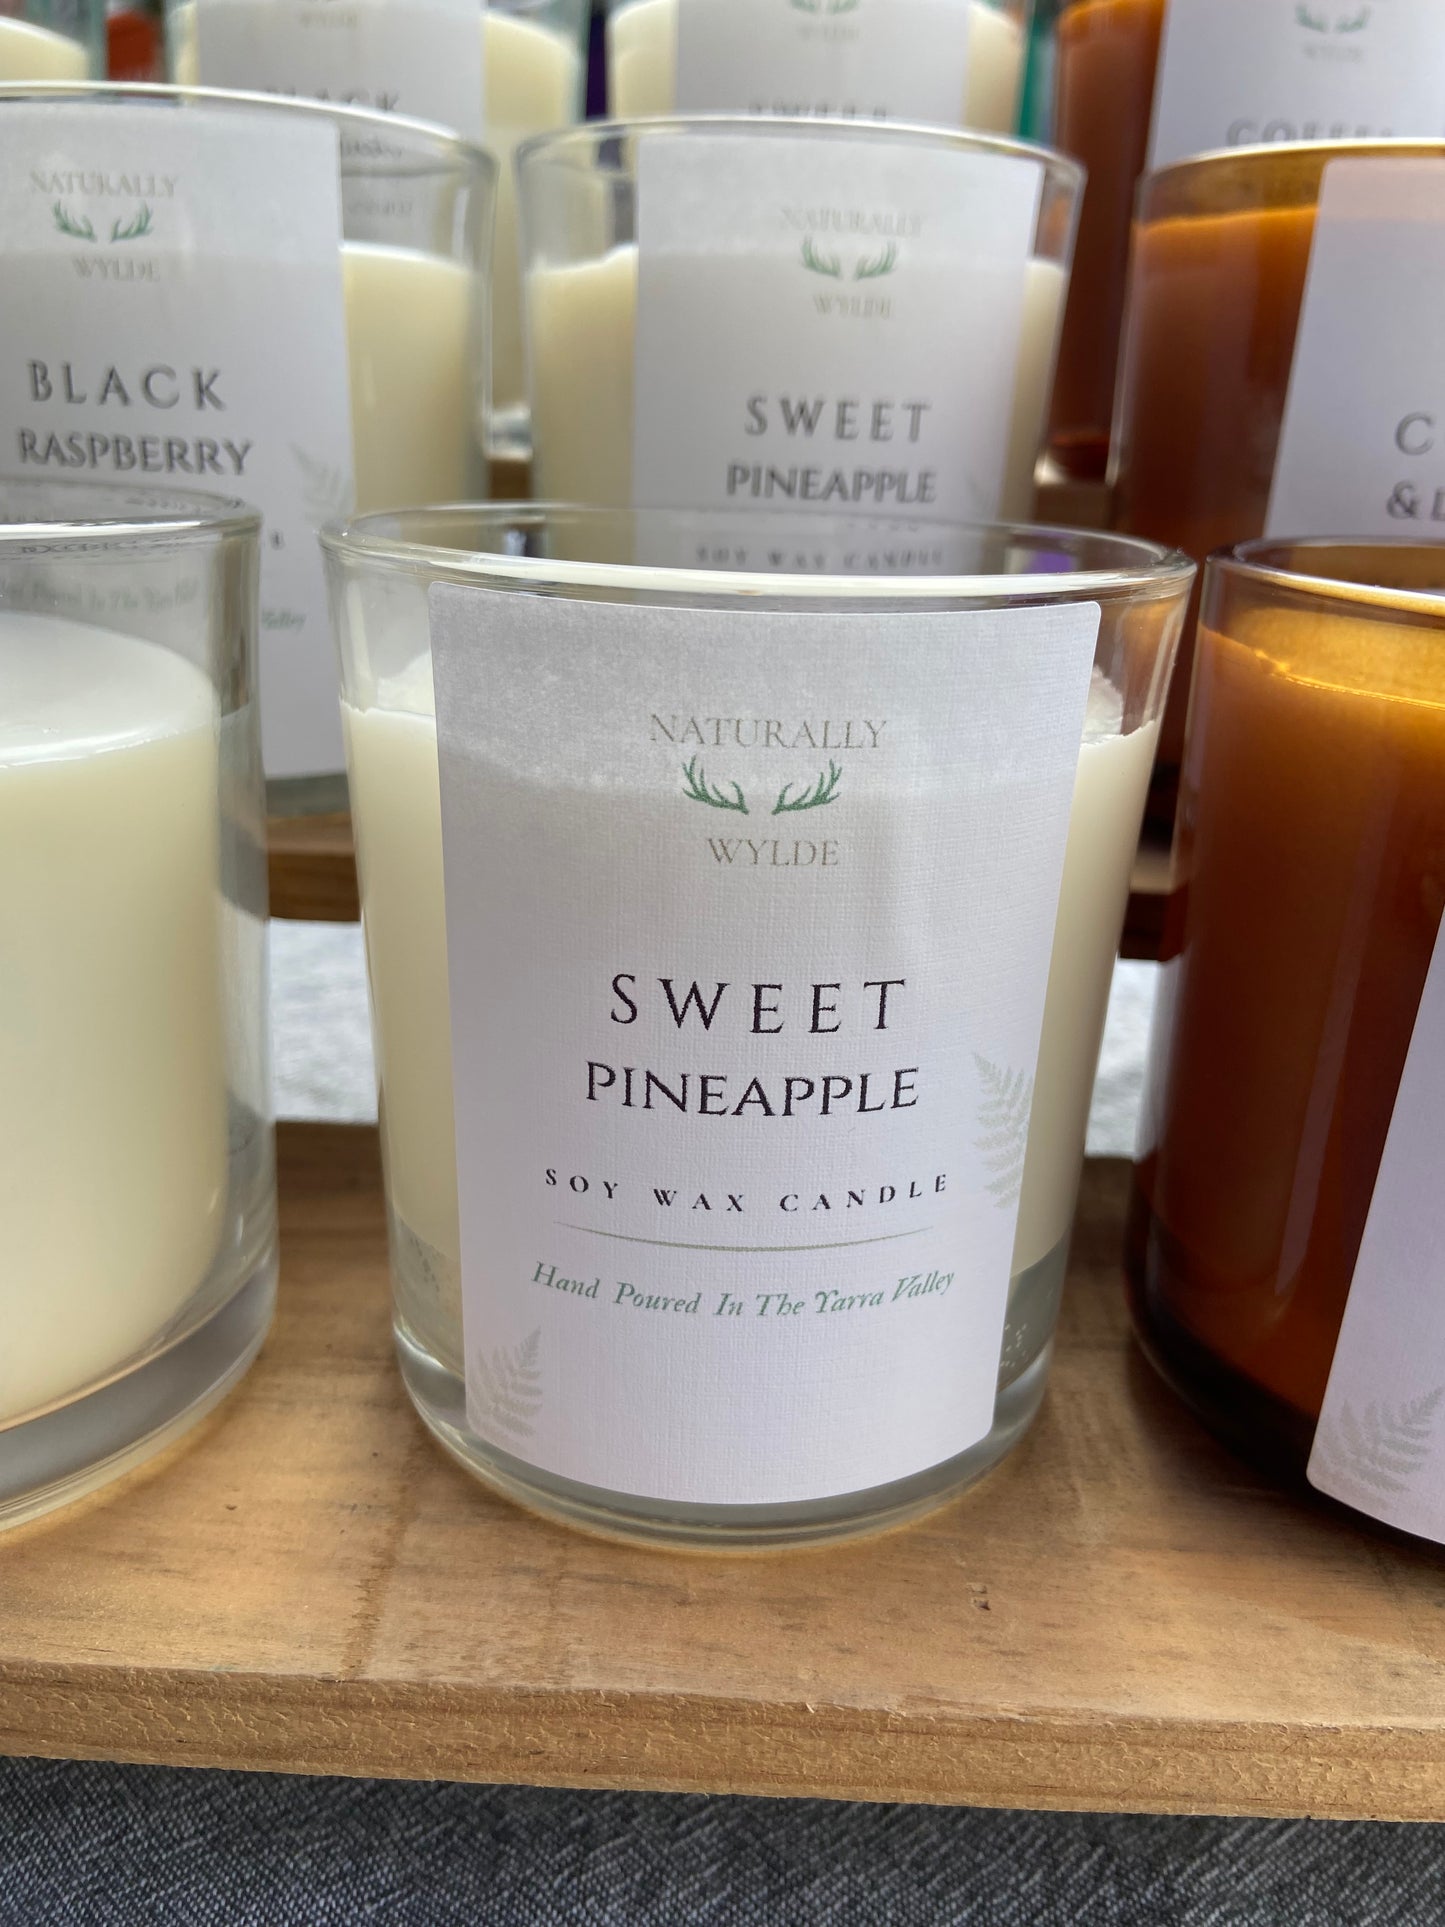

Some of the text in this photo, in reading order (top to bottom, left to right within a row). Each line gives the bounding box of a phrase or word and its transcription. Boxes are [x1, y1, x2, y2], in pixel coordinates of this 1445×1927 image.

[30, 170, 178, 197] NATURALLY
[27, 359, 226, 411] BLACK
[744, 395, 932, 443] SWEET
[17, 427, 252, 476] RASPBERRY
[726, 462, 937, 504] PINEAPPLE
[650, 713, 887, 749] NATURALLY
[707, 837, 840, 867] WYLDE
[610, 973, 906, 1034] SWEET
[586, 1060, 920, 1117] PINEAPPLE
[545, 1168, 948, 1212] SOY WAX CANDLE
[531, 1261, 956, 1317] Hand Poured In The Yarra Valley
